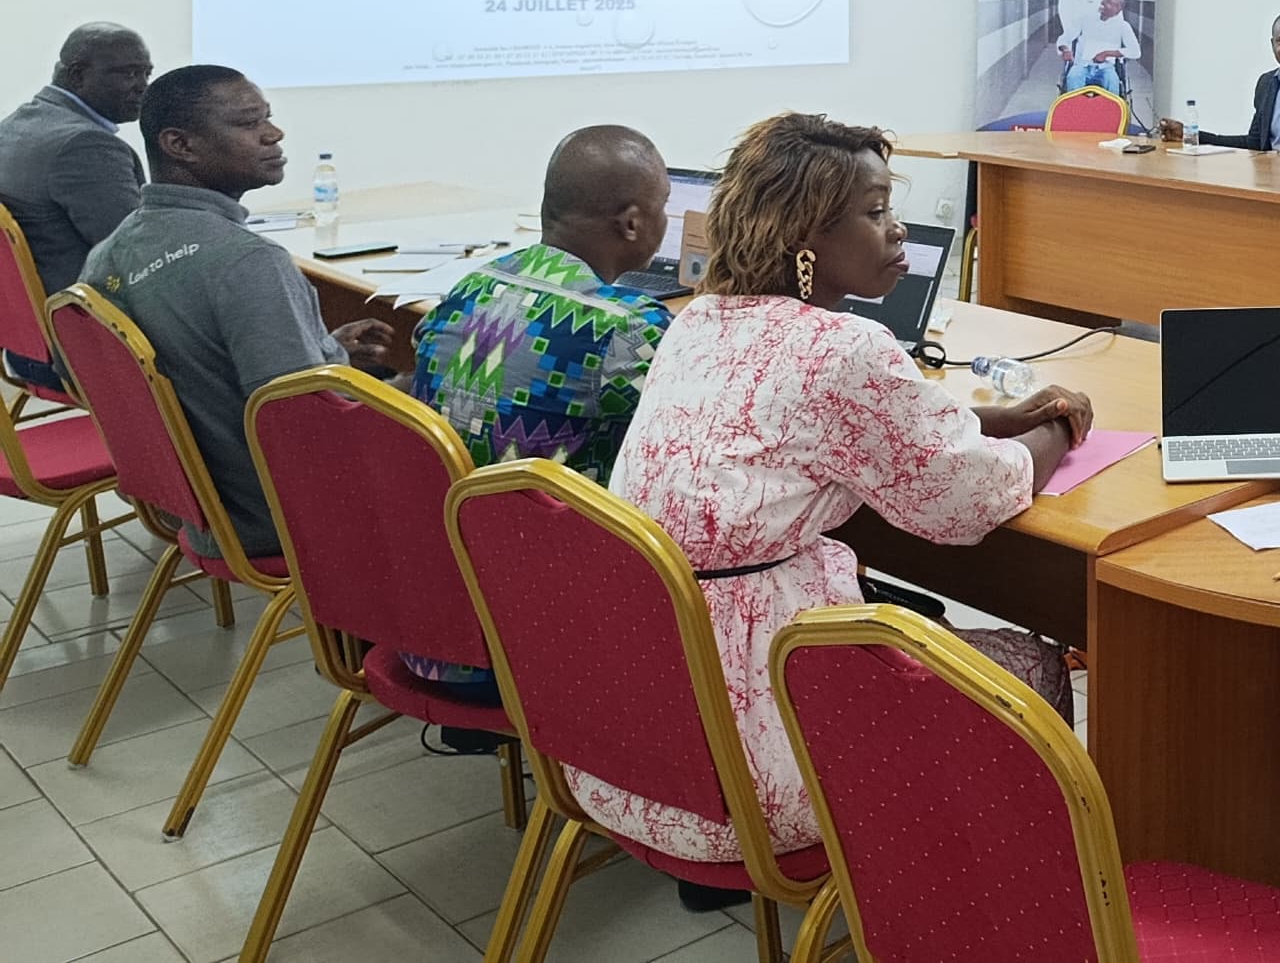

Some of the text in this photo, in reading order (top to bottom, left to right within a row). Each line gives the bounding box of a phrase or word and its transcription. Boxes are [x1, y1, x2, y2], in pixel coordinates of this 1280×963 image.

[485, 0, 507, 13] 24
[149, 258, 164, 272] to
[165, 243, 199, 263] help
